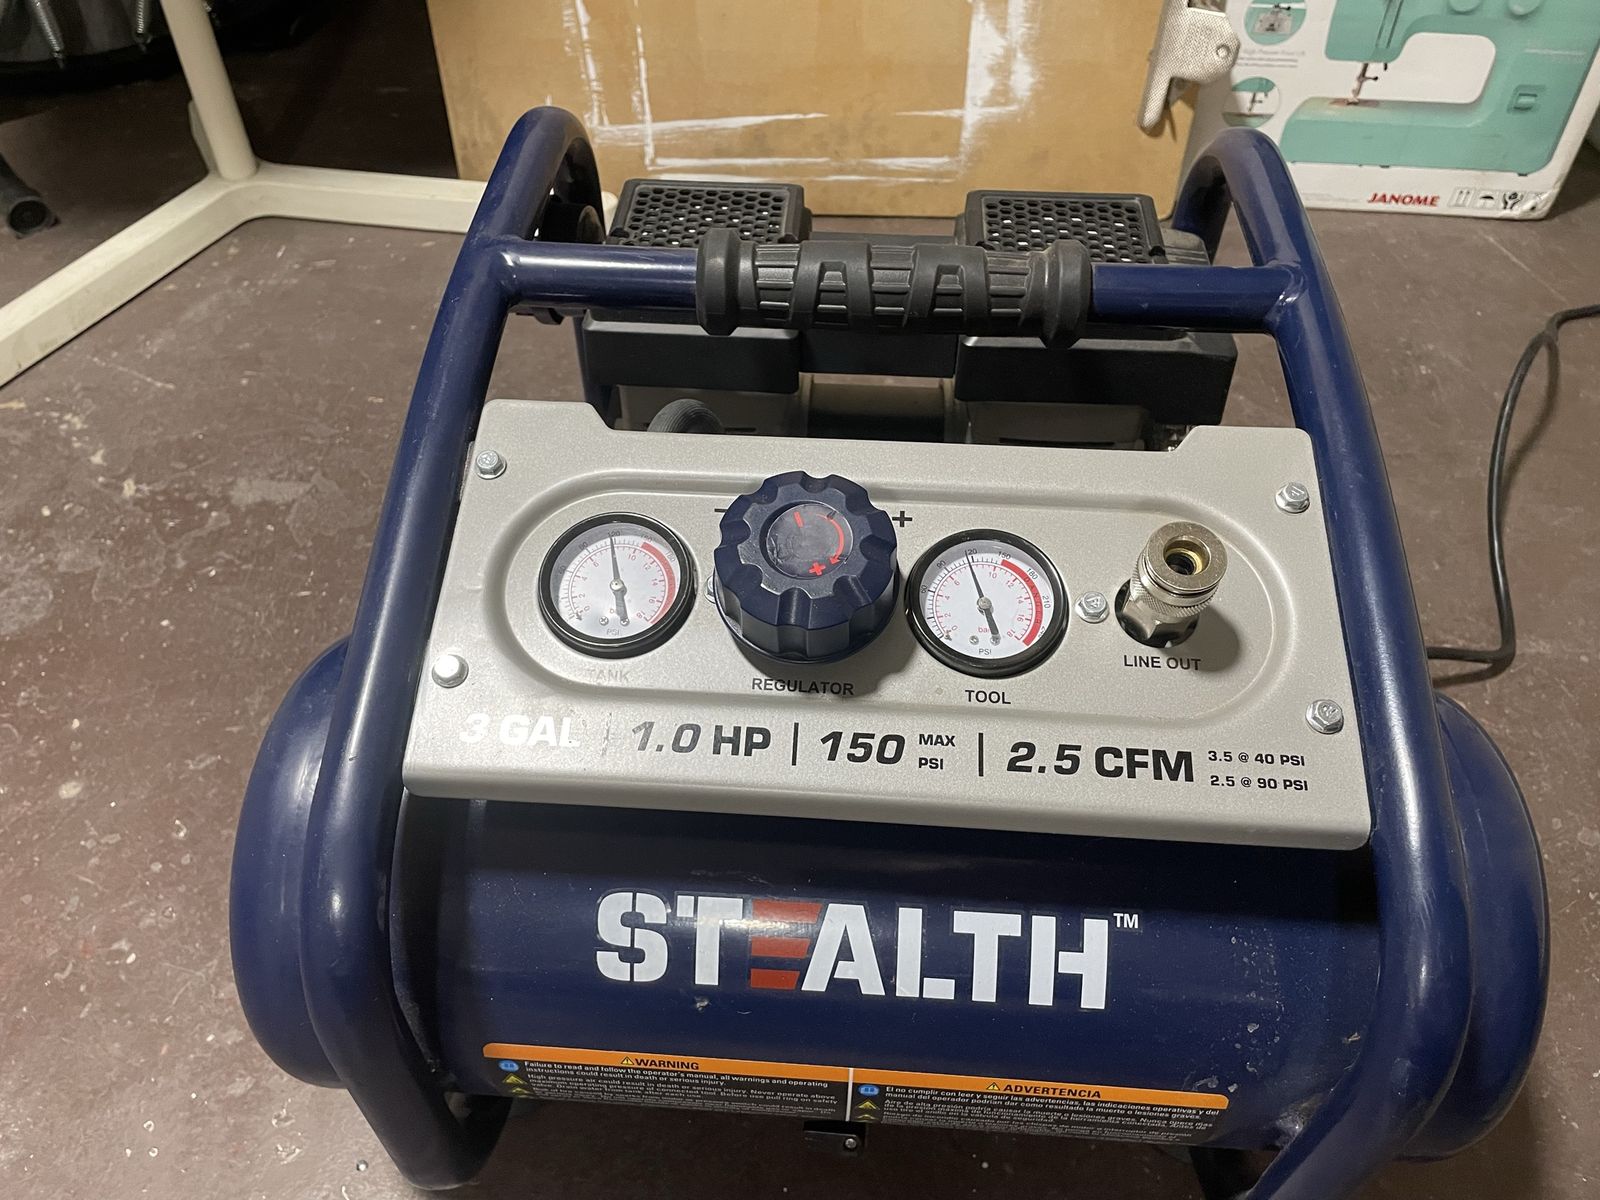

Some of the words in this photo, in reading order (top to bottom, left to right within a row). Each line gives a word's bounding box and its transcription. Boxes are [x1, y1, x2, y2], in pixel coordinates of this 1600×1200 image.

[1367, 193, 1441, 207] JANOME
[998, 551, 1011, 560] 150
[936, 560, 947, 569] 90
[1026, 568, 1039, 580] 180
[1042, 595, 1051, 609] 210
[979, 648, 992, 656] PSI
[1123, 654, 1161, 669] LINE
[1166, 657, 1201, 671] OUT
[752, 678, 854, 696] REGULATOR
[965, 690, 1011, 704] TOOL
[460, 712, 490, 743] 3
[499, 714, 580, 747] GAL
[631, 721, 702, 753] 1.0
[712, 725, 771, 757] HP
[918, 733, 956, 747] MAX
[820, 731, 906, 765] 150
[918, 757, 944, 770] PSI
[1006, 741, 1082, 776] 2.5
[1094, 746, 1194, 782] CFM
[1208, 750, 1233, 762] 3.5
[1238, 752, 1249, 763] @
[1254, 753, 1275, 764] 40
[1280, 754, 1305, 766] PSI
[1210, 775, 1235, 787] 2.5
[1240, 776, 1252, 788] @
[1257, 777, 1277, 789] 90
[1283, 779, 1308, 791] PSI
[595, 891, 1110, 1010] STEALTH
[1113, 913, 1139, 929] TM
[635, 1058, 700, 1071] WARNING
[643, 1069, 685, 1078] operator's
[732, 1076, 769, 1085] warnings
[788, 1080, 828, 1089] operating
[1003, 1084, 1101, 1099] ADVERTENCIA
[908, 1088, 938, 1096] cumplir
[1025, 1097, 1081, 1106] advertencias,
[1098, 1102, 1150, 1111] indicaciones
[1152, 1106, 1196, 1115] operativas
